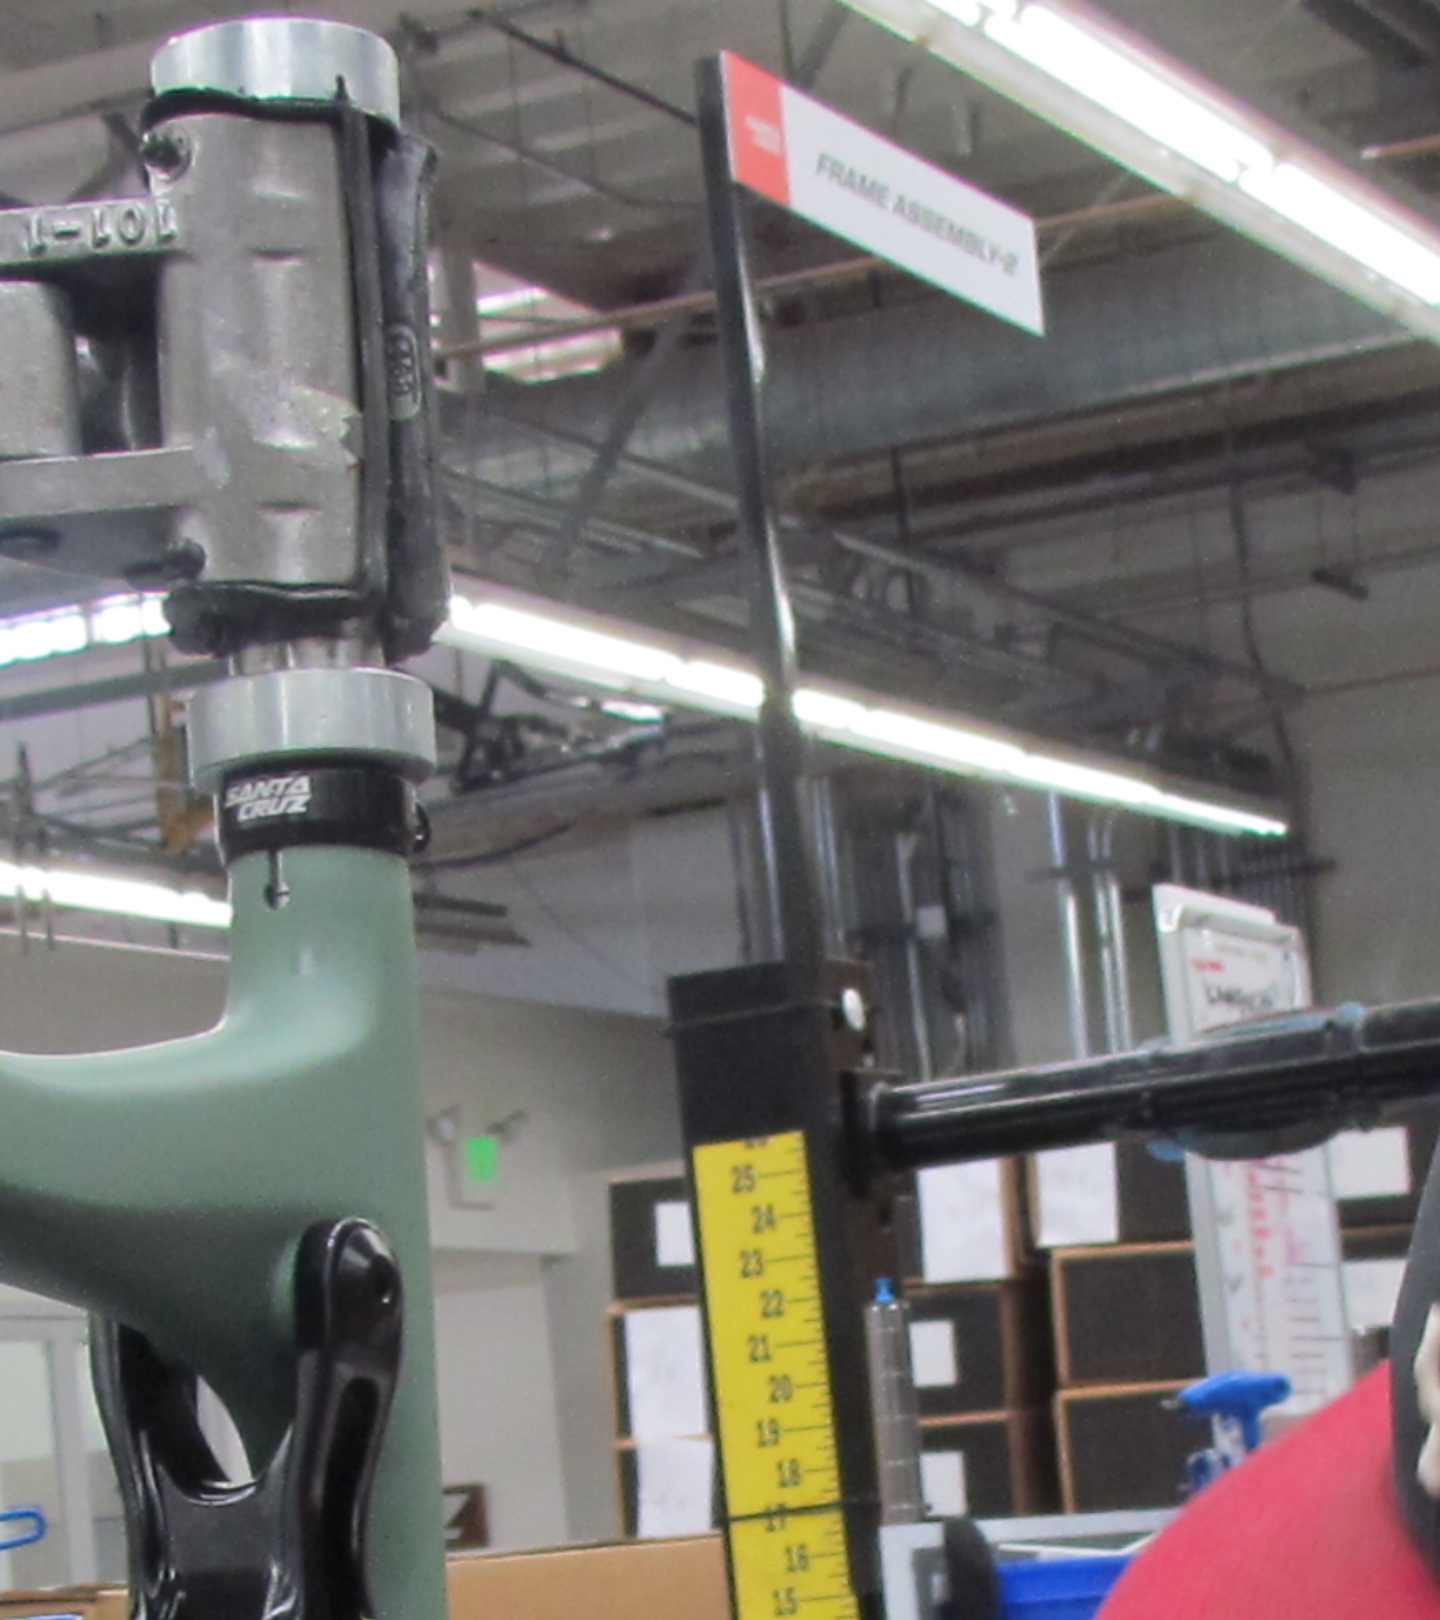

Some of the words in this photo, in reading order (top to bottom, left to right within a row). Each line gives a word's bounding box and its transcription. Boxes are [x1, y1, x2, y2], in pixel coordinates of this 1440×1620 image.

[815, 152, 891, 212] FRAME
[224, 774, 311, 809] SANTA
[237, 794, 311, 822] CRUZ
[731, 1164, 756, 1195] 25
[750, 1203, 777, 1235] 24
[740, 1248, 764, 1279] 23
[760, 1289, 784, 1319] 22
[747, 1334, 772, 1364] 21
[768, 1374, 793, 1404] 20
[756, 1417, 780, 1448] 19
[776, 1457, 801, 1488] 18
[764, 1503, 787, 1532] 17
[784, 1544, 809, 1573] 16
[773, 1586, 798, 1617] 15
